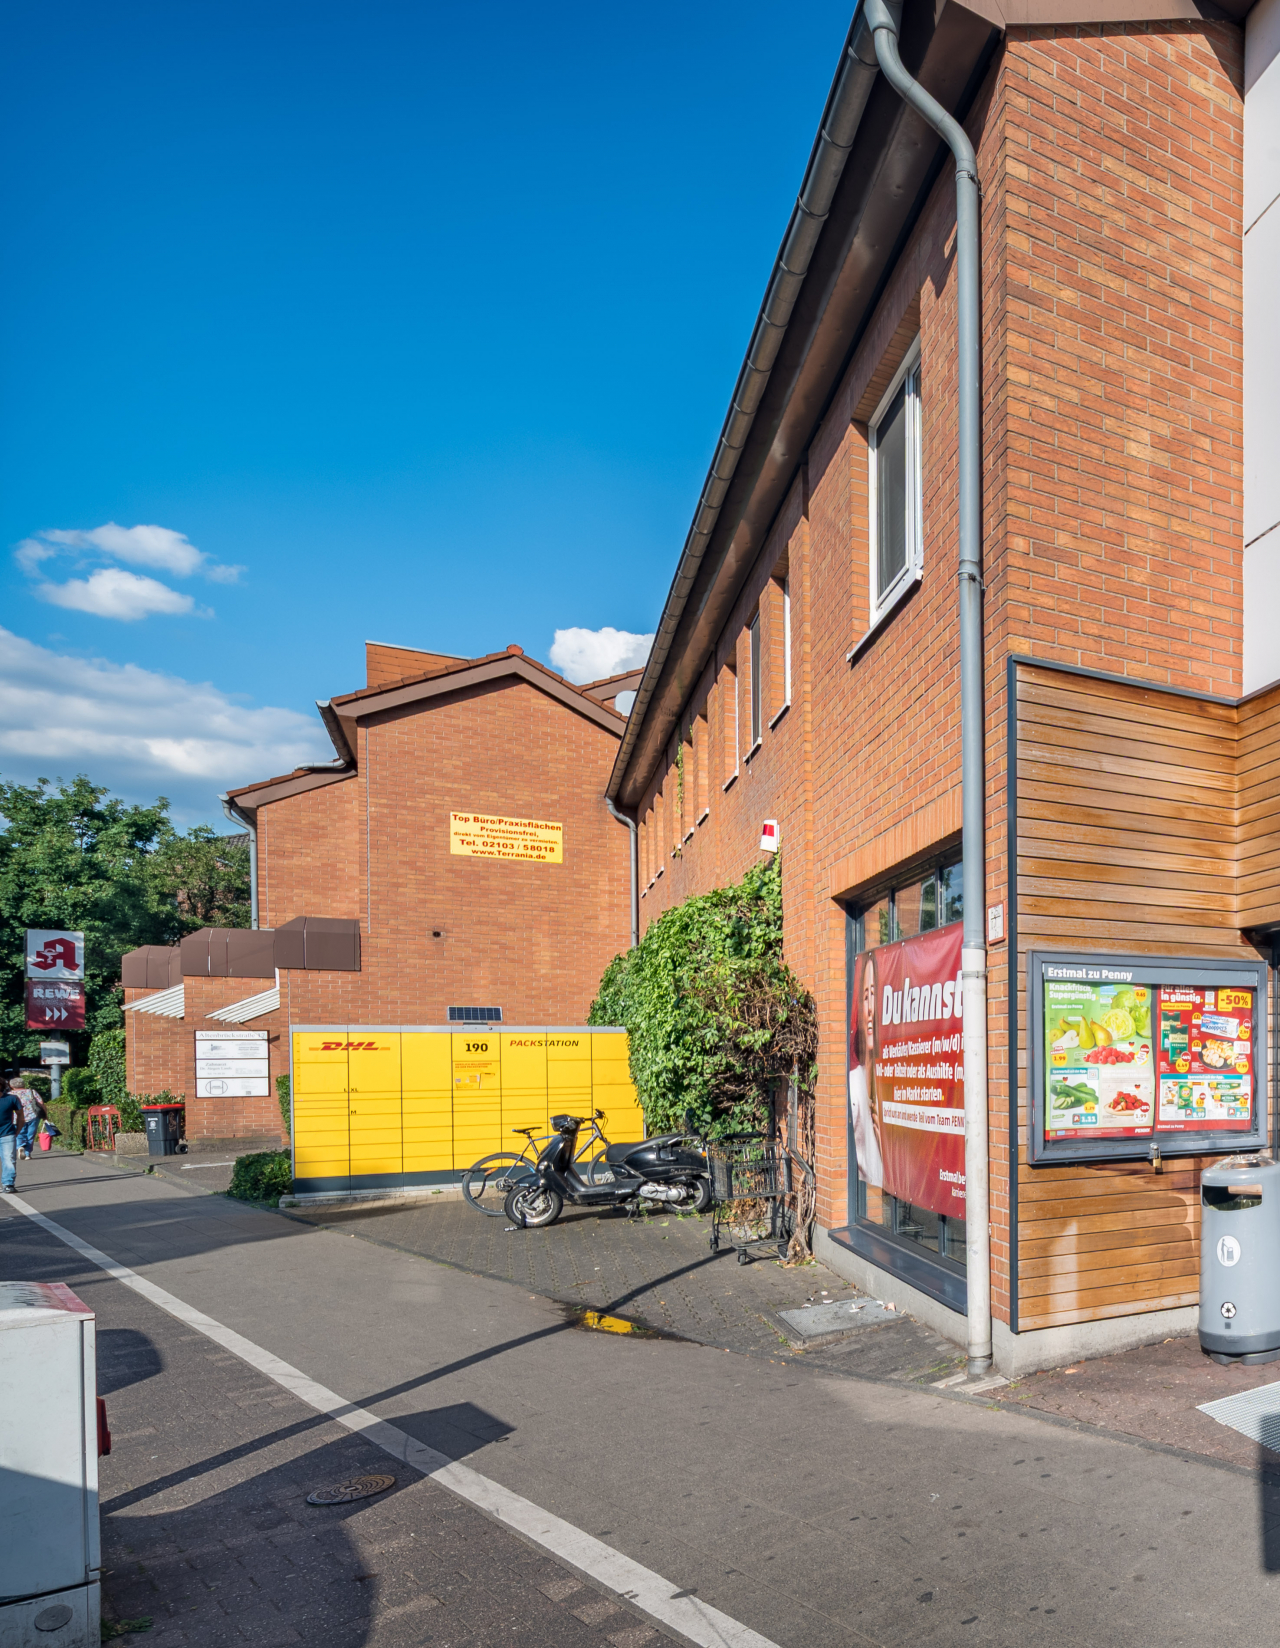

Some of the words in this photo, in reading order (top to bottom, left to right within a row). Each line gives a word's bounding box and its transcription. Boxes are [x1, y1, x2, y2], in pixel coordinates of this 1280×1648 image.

[452, 814, 470, 823] Top
[473, 816, 561, 831] Büro/Praxisflächen
[480, 827, 538, 837] Provisionsfrei,
[482, 841, 514, 849] 02103
[472, 850, 546, 860] www.Terrania.de
[1048, 967, 1086, 978] Erstmal
[1102, 970, 1132, 981] Penny
[1049, 983, 1092, 992] Knackfrisch,
[1161, 985, 1173, 993] Für
[1175, 985, 1194, 993] alles
[33, 989, 80, 999] REWE
[882, 985, 902, 1026] Du
[903, 970, 964, 1023] kannst
[1049, 991, 1099, 1000] Supergünstig.
[1161, 992, 1169, 1000] in
[1170, 993, 1203, 1003] günstig.
[1221, 995, 1248, 1006] -50%
[321, 1042, 379, 1050] DHL
[466, 1043, 488, 1052] 190
[932, 1034, 960, 1055] (m/w/d)
[907, 1064, 917, 1077] oder
[918, 1063, 926, 1078] als
[926, 1062, 953, 1079] Aushilfe
[907, 1086, 920, 1101] Markt
[920, 1086, 944, 1101] starten.
[925, 1114, 935, 1125] vom
[937, 1114, 950, 1126] Team
[951, 1115, 965, 1128] PENN
[940, 1169, 959, 1183] Erstmal
